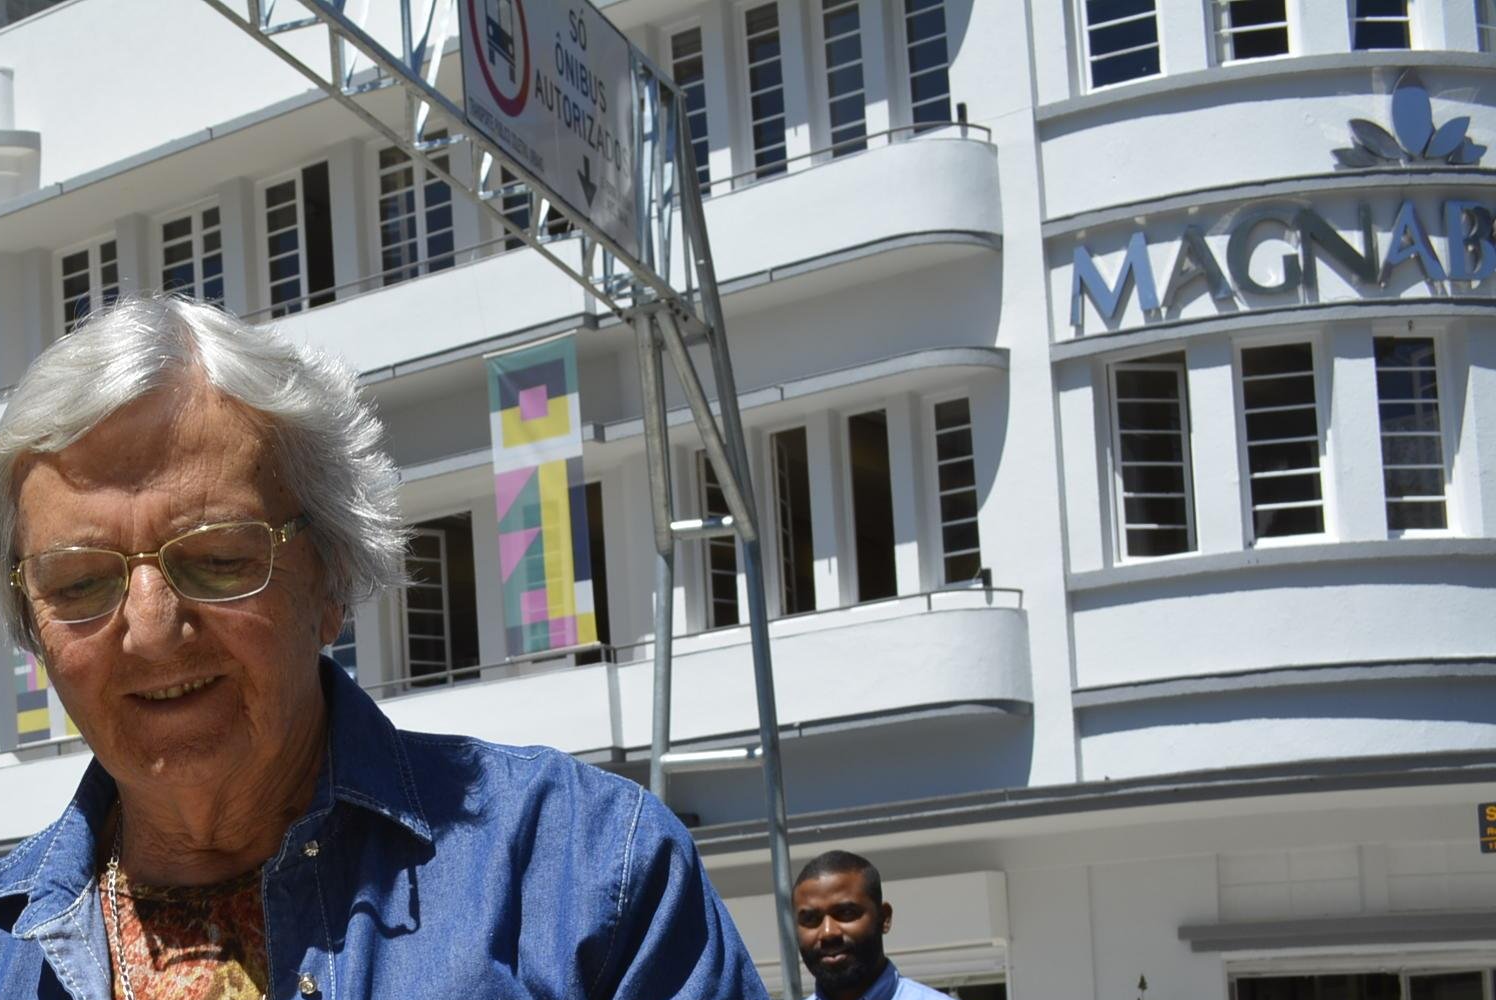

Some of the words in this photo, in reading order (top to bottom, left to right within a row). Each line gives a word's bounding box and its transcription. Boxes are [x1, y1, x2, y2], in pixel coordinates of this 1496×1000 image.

[569, 8, 587, 50] SÓ
[555, 32, 607, 113] ÔNIBUS
[535, 68, 630, 178] AUTORIZADOS
